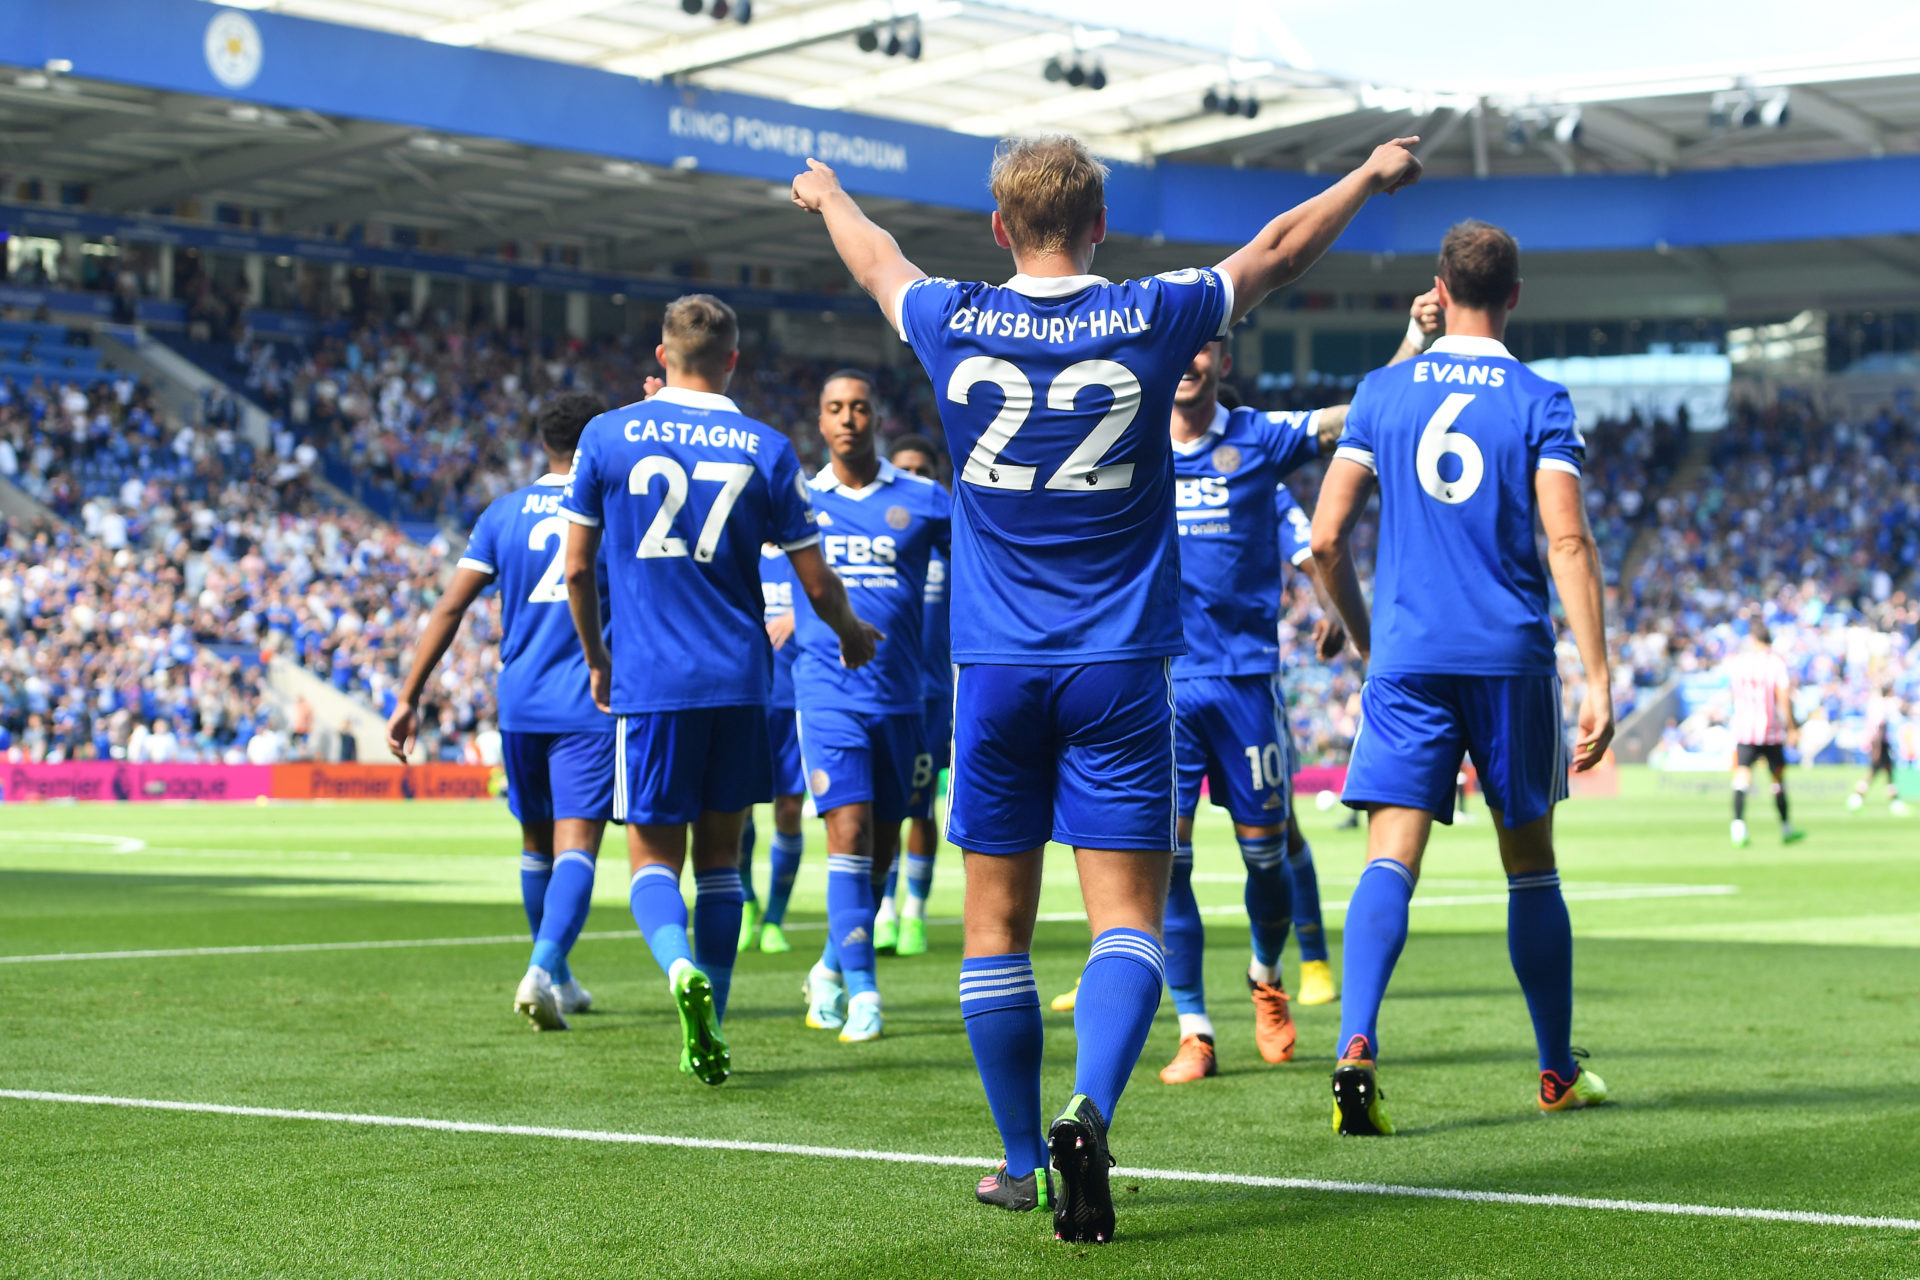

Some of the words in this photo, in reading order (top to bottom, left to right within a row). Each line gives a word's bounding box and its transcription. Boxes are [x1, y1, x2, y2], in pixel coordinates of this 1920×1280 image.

[668, 106, 731, 145] KING
[733, 115, 815, 157] POWER
[817, 130, 908, 173] STADIUM
[949, 306, 1151, 344] DEWSBURY-HALL
[1413, 361, 1506, 387] EVANS
[624, 419, 760, 455] CASTAGNE
[947, 355, 1142, 492] 22
[1416, 392, 1485, 504] 6
[628, 455, 756, 563] 27
[1175, 475, 1230, 508] BS
[824, 535, 897, 564] FBS
[10, 769, 100, 796] Premier
[140, 769, 228, 799] Lague
[311, 769, 392, 795] Premier
[912, 752, 934, 789] 8
[1244, 742, 1282, 790] 10
